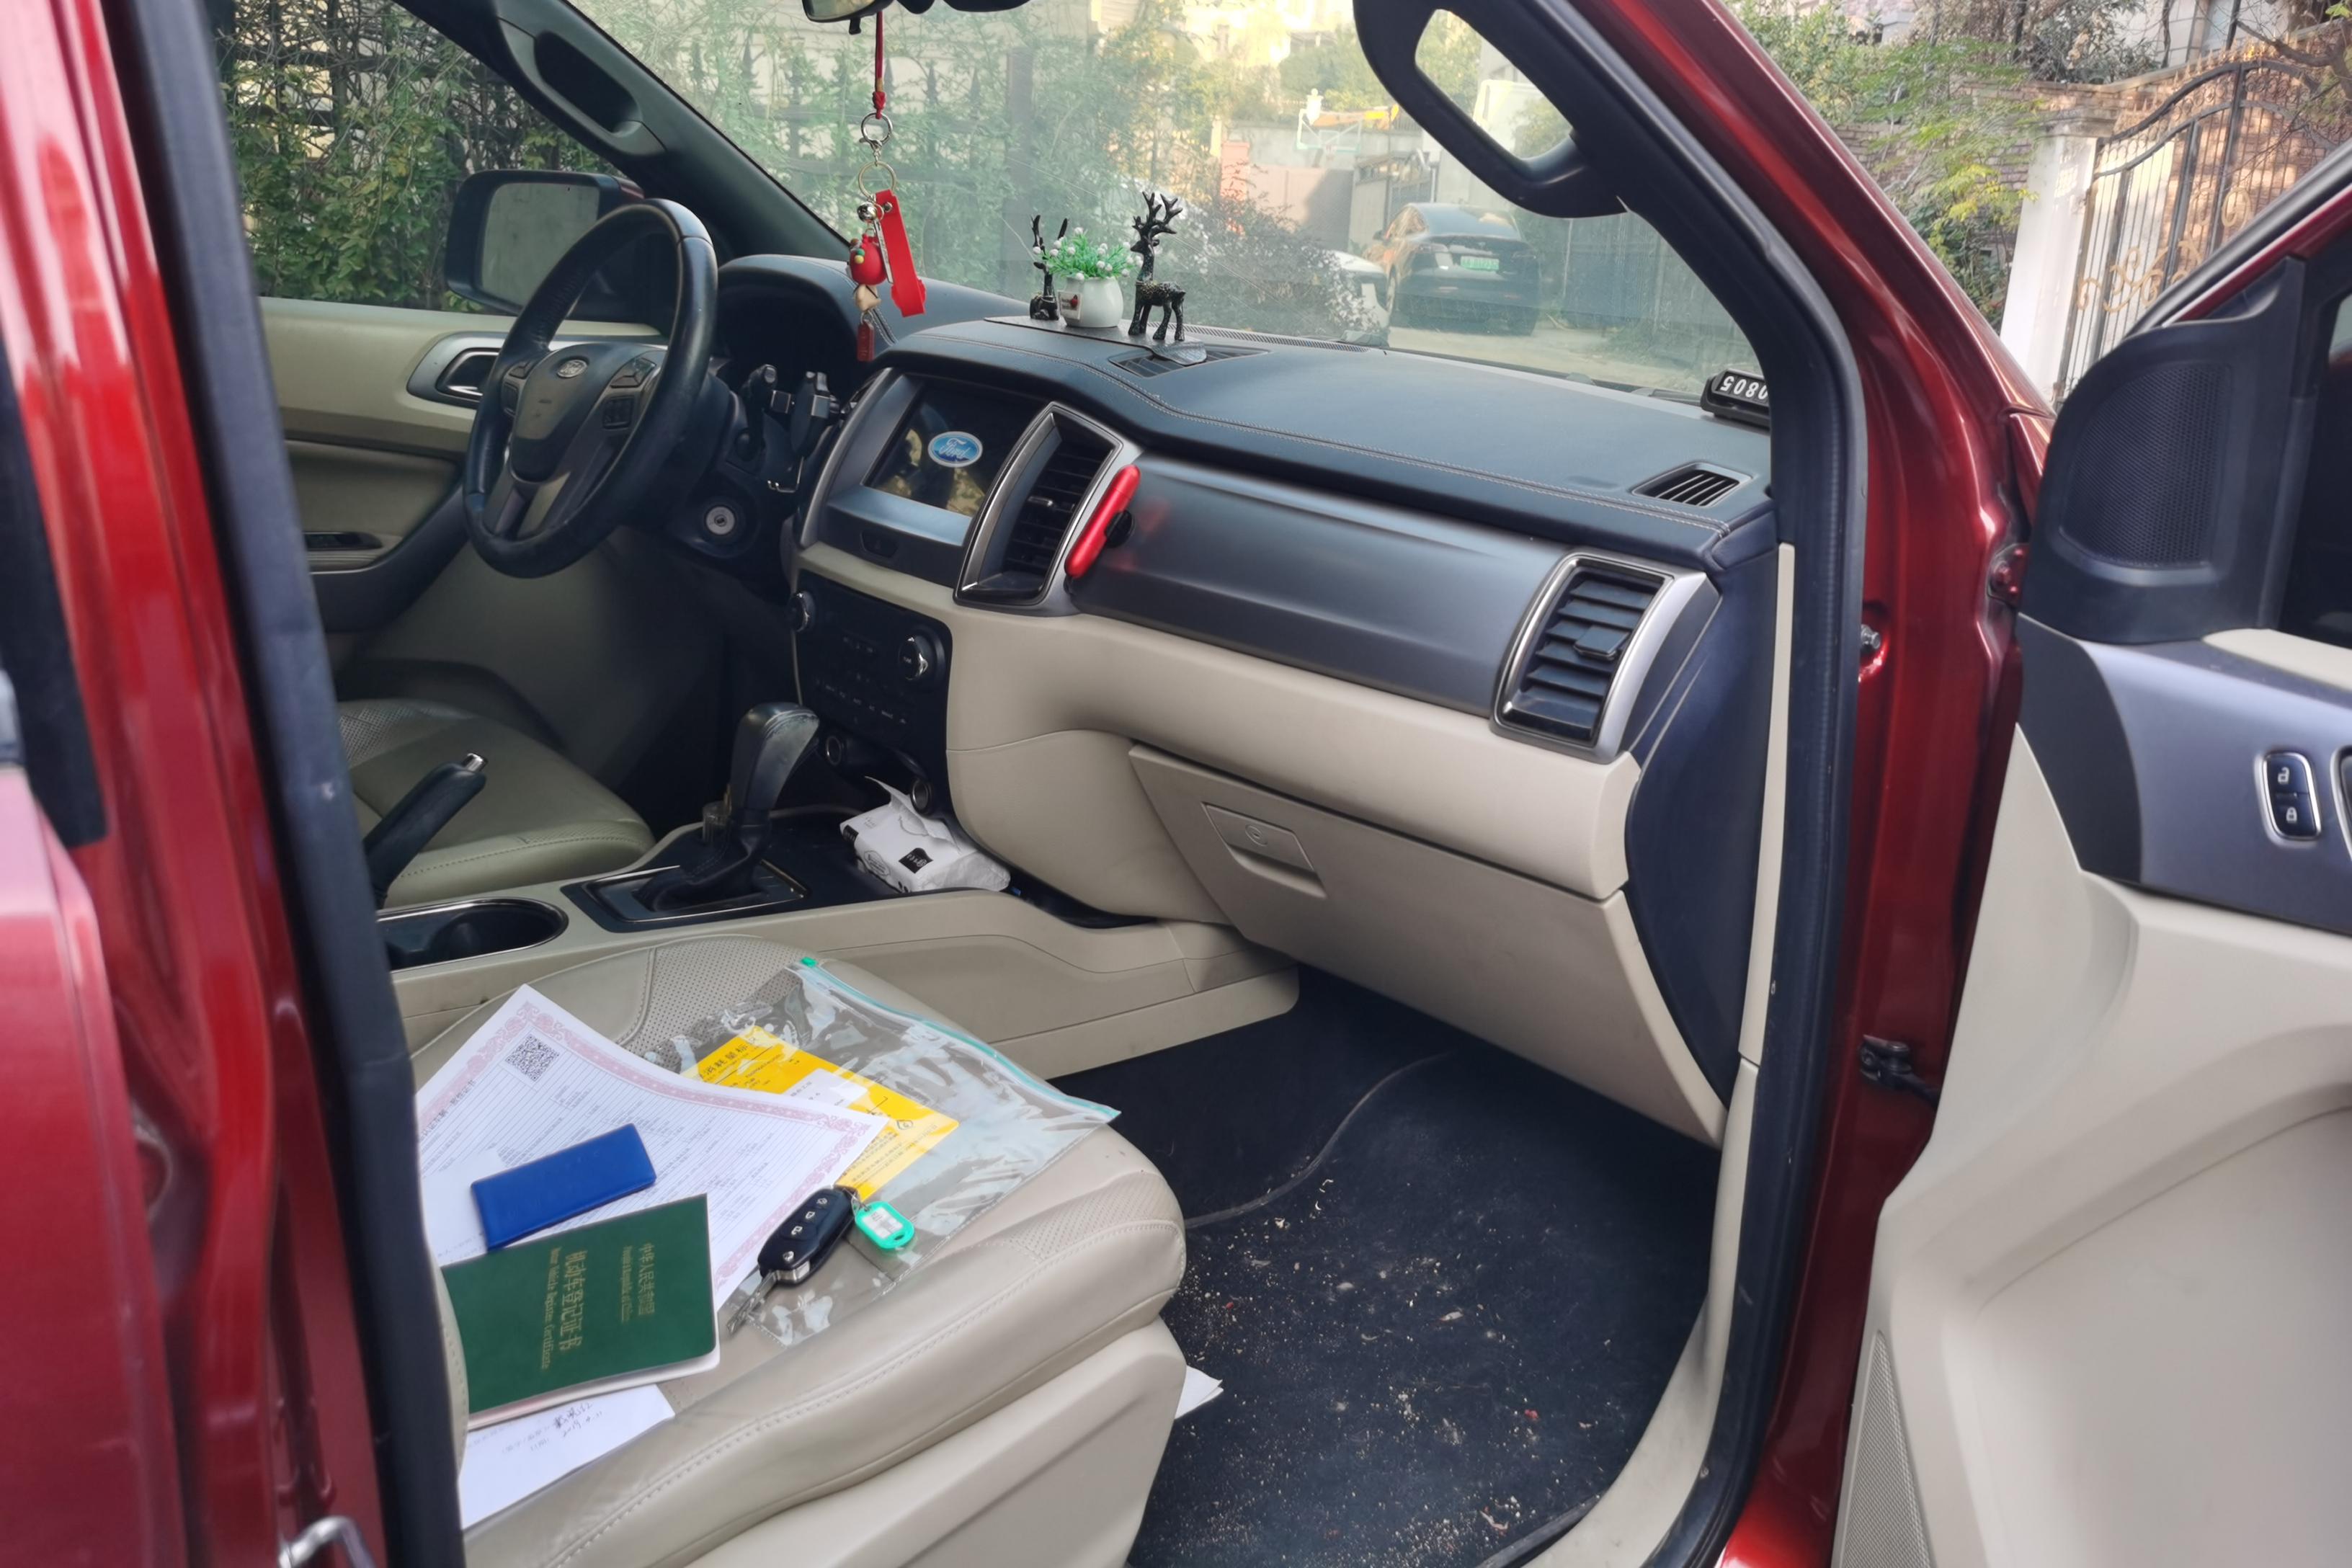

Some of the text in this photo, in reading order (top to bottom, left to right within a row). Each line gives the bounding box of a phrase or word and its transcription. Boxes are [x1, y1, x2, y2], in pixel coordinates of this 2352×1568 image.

[939, 437, 971, 460] Ford
[558, 1250, 588, 1350] 机动车登记证书
[638, 1243, 655, 1316] 中华人民共和国
